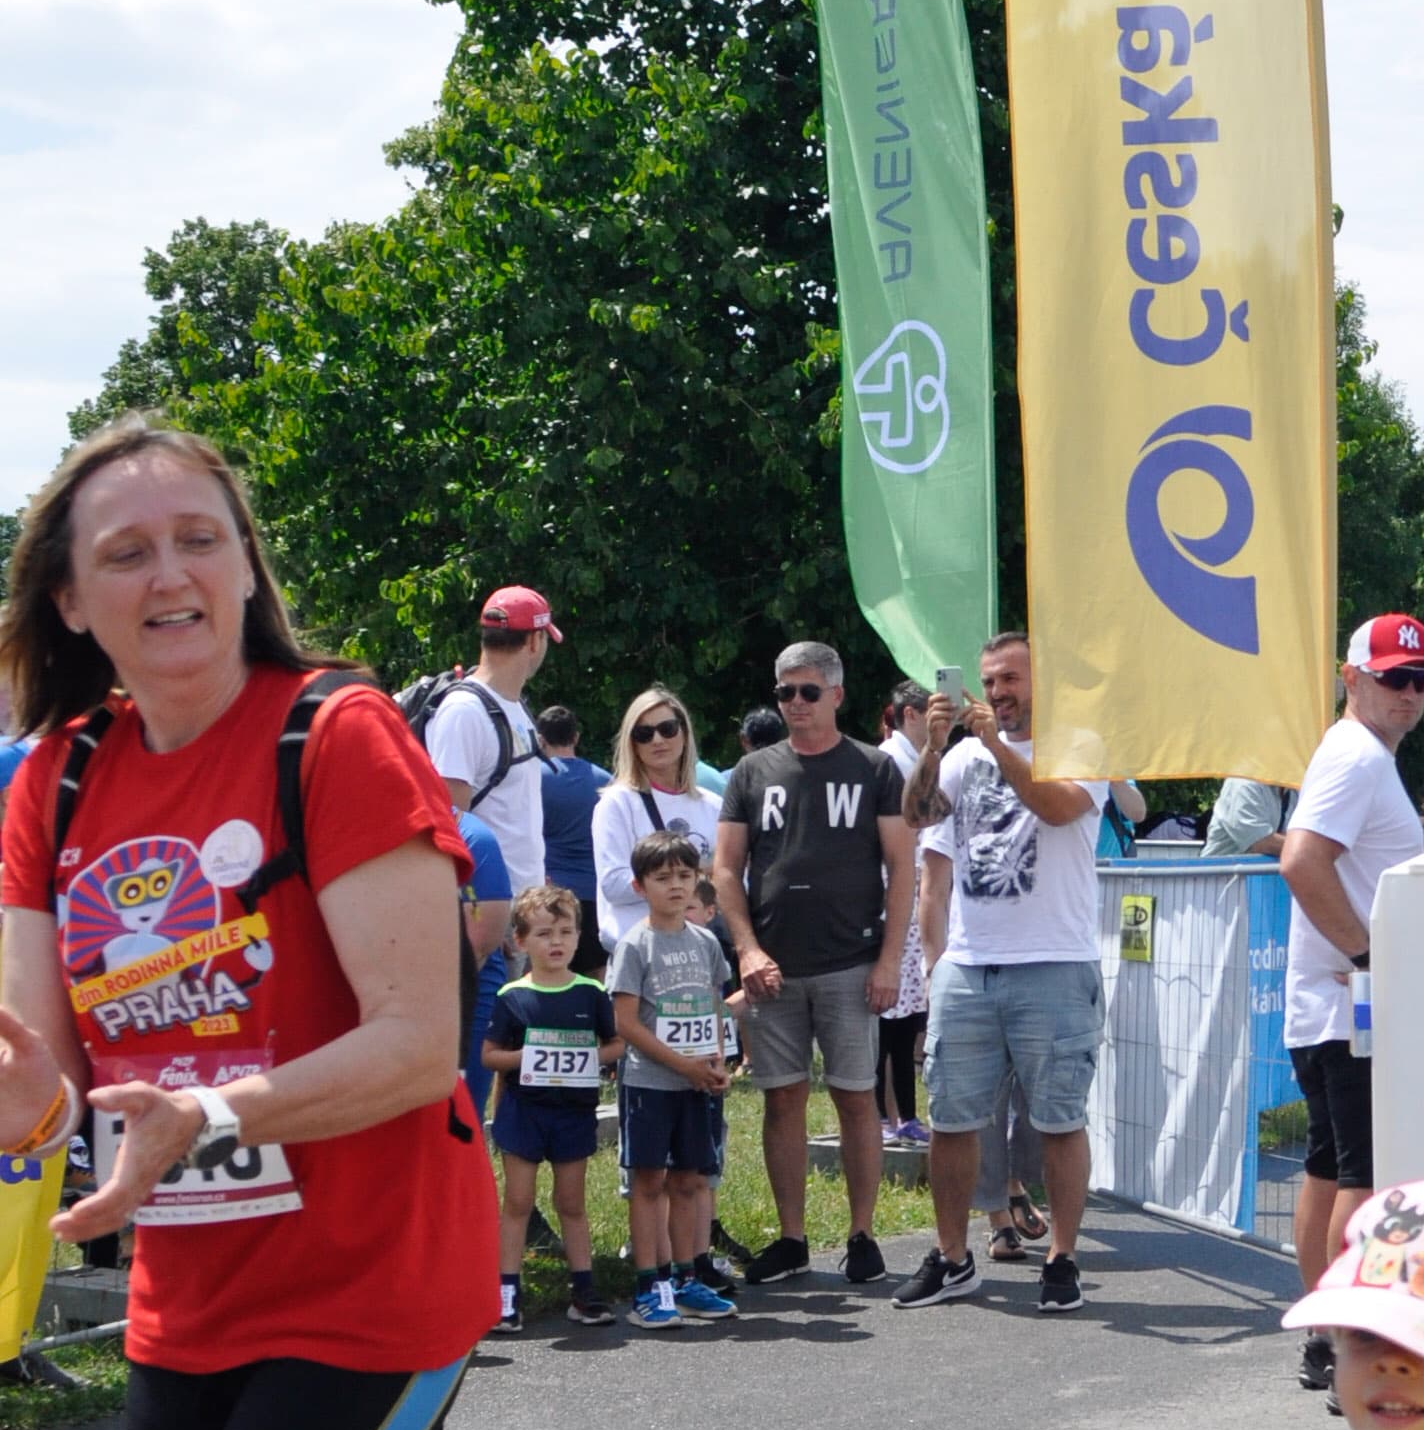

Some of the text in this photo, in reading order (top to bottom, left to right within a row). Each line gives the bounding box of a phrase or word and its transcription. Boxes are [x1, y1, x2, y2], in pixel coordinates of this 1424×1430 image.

[94, 972, 249, 1039] PRAHA
[666, 1018, 712, 1043] 2136
[533, 1050, 589, 1073] 2137
